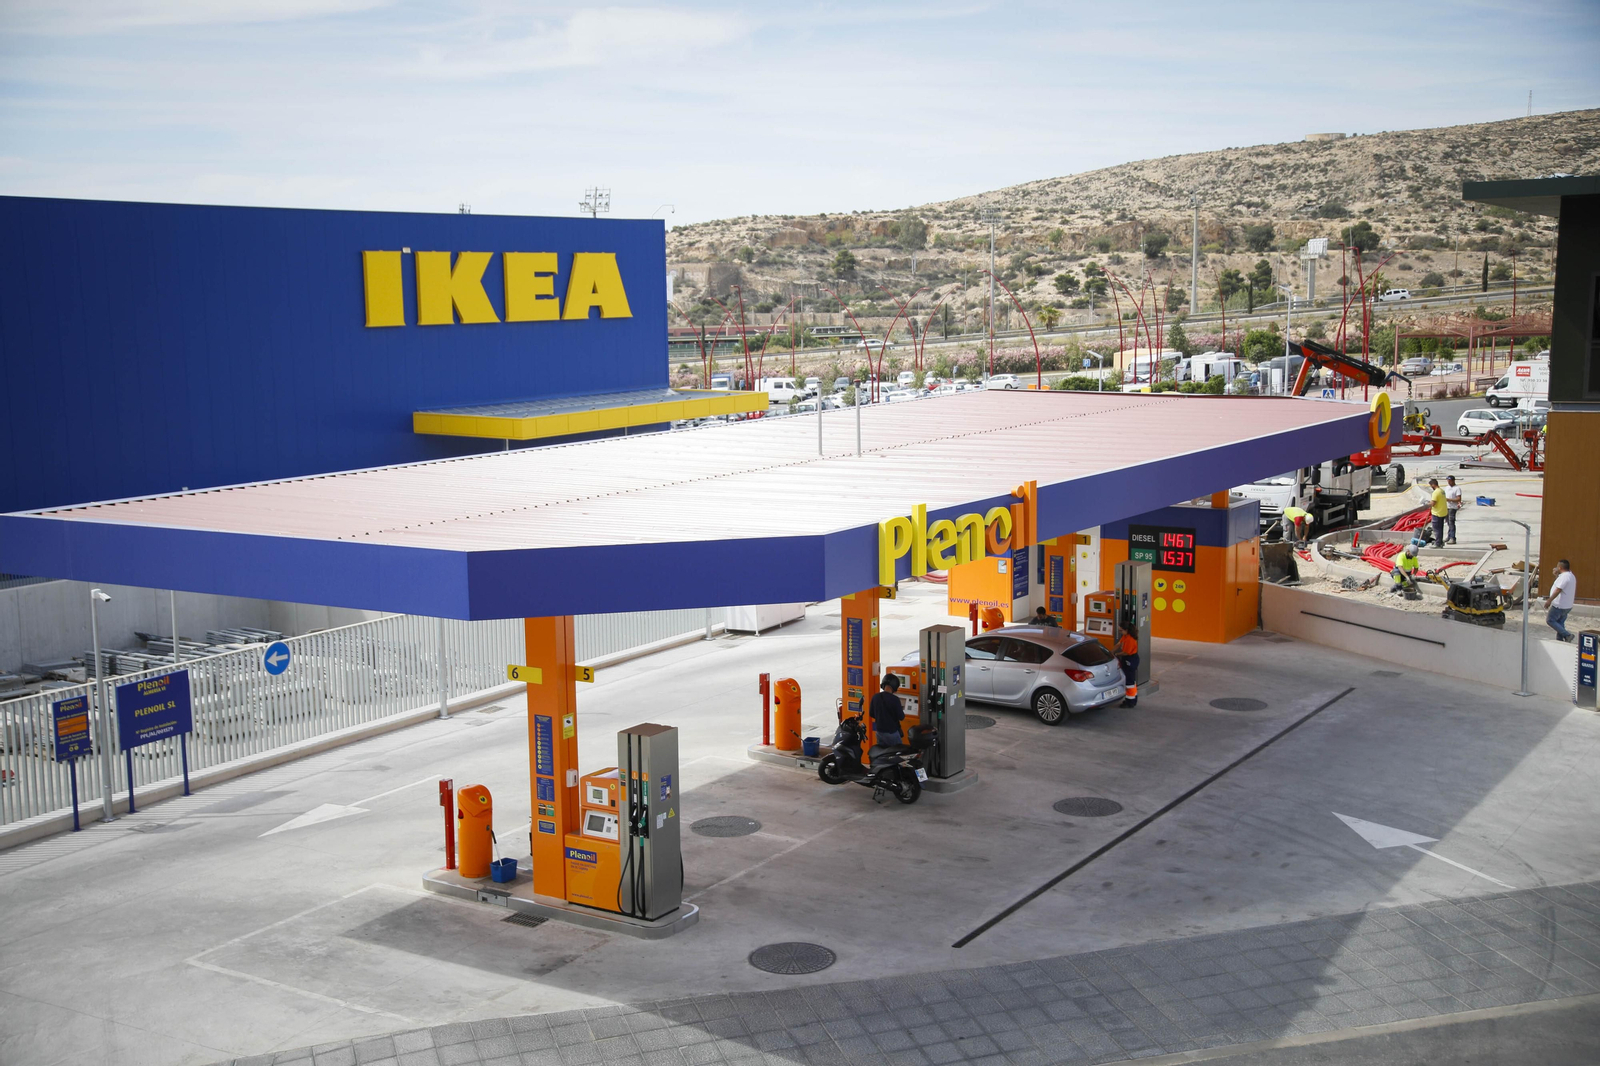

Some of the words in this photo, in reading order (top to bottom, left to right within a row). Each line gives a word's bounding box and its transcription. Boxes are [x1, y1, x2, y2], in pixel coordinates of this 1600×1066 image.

[362, 250, 633, 327] IKEA
[1082, 535, 1087, 544] 1
[1132, 534, 1155, 542] DIESEL
[1134, 551, 1143, 559] SP
[885, 588, 892, 598] 3
[512, 667, 519, 679] 6
[583, 668, 590, 680] 5
[137, 675, 170, 691] Plenoil
[134, 703, 166, 717] PLENOIL
[167, 700, 176, 709] SL
[570, 850, 596, 861] Plenoil
